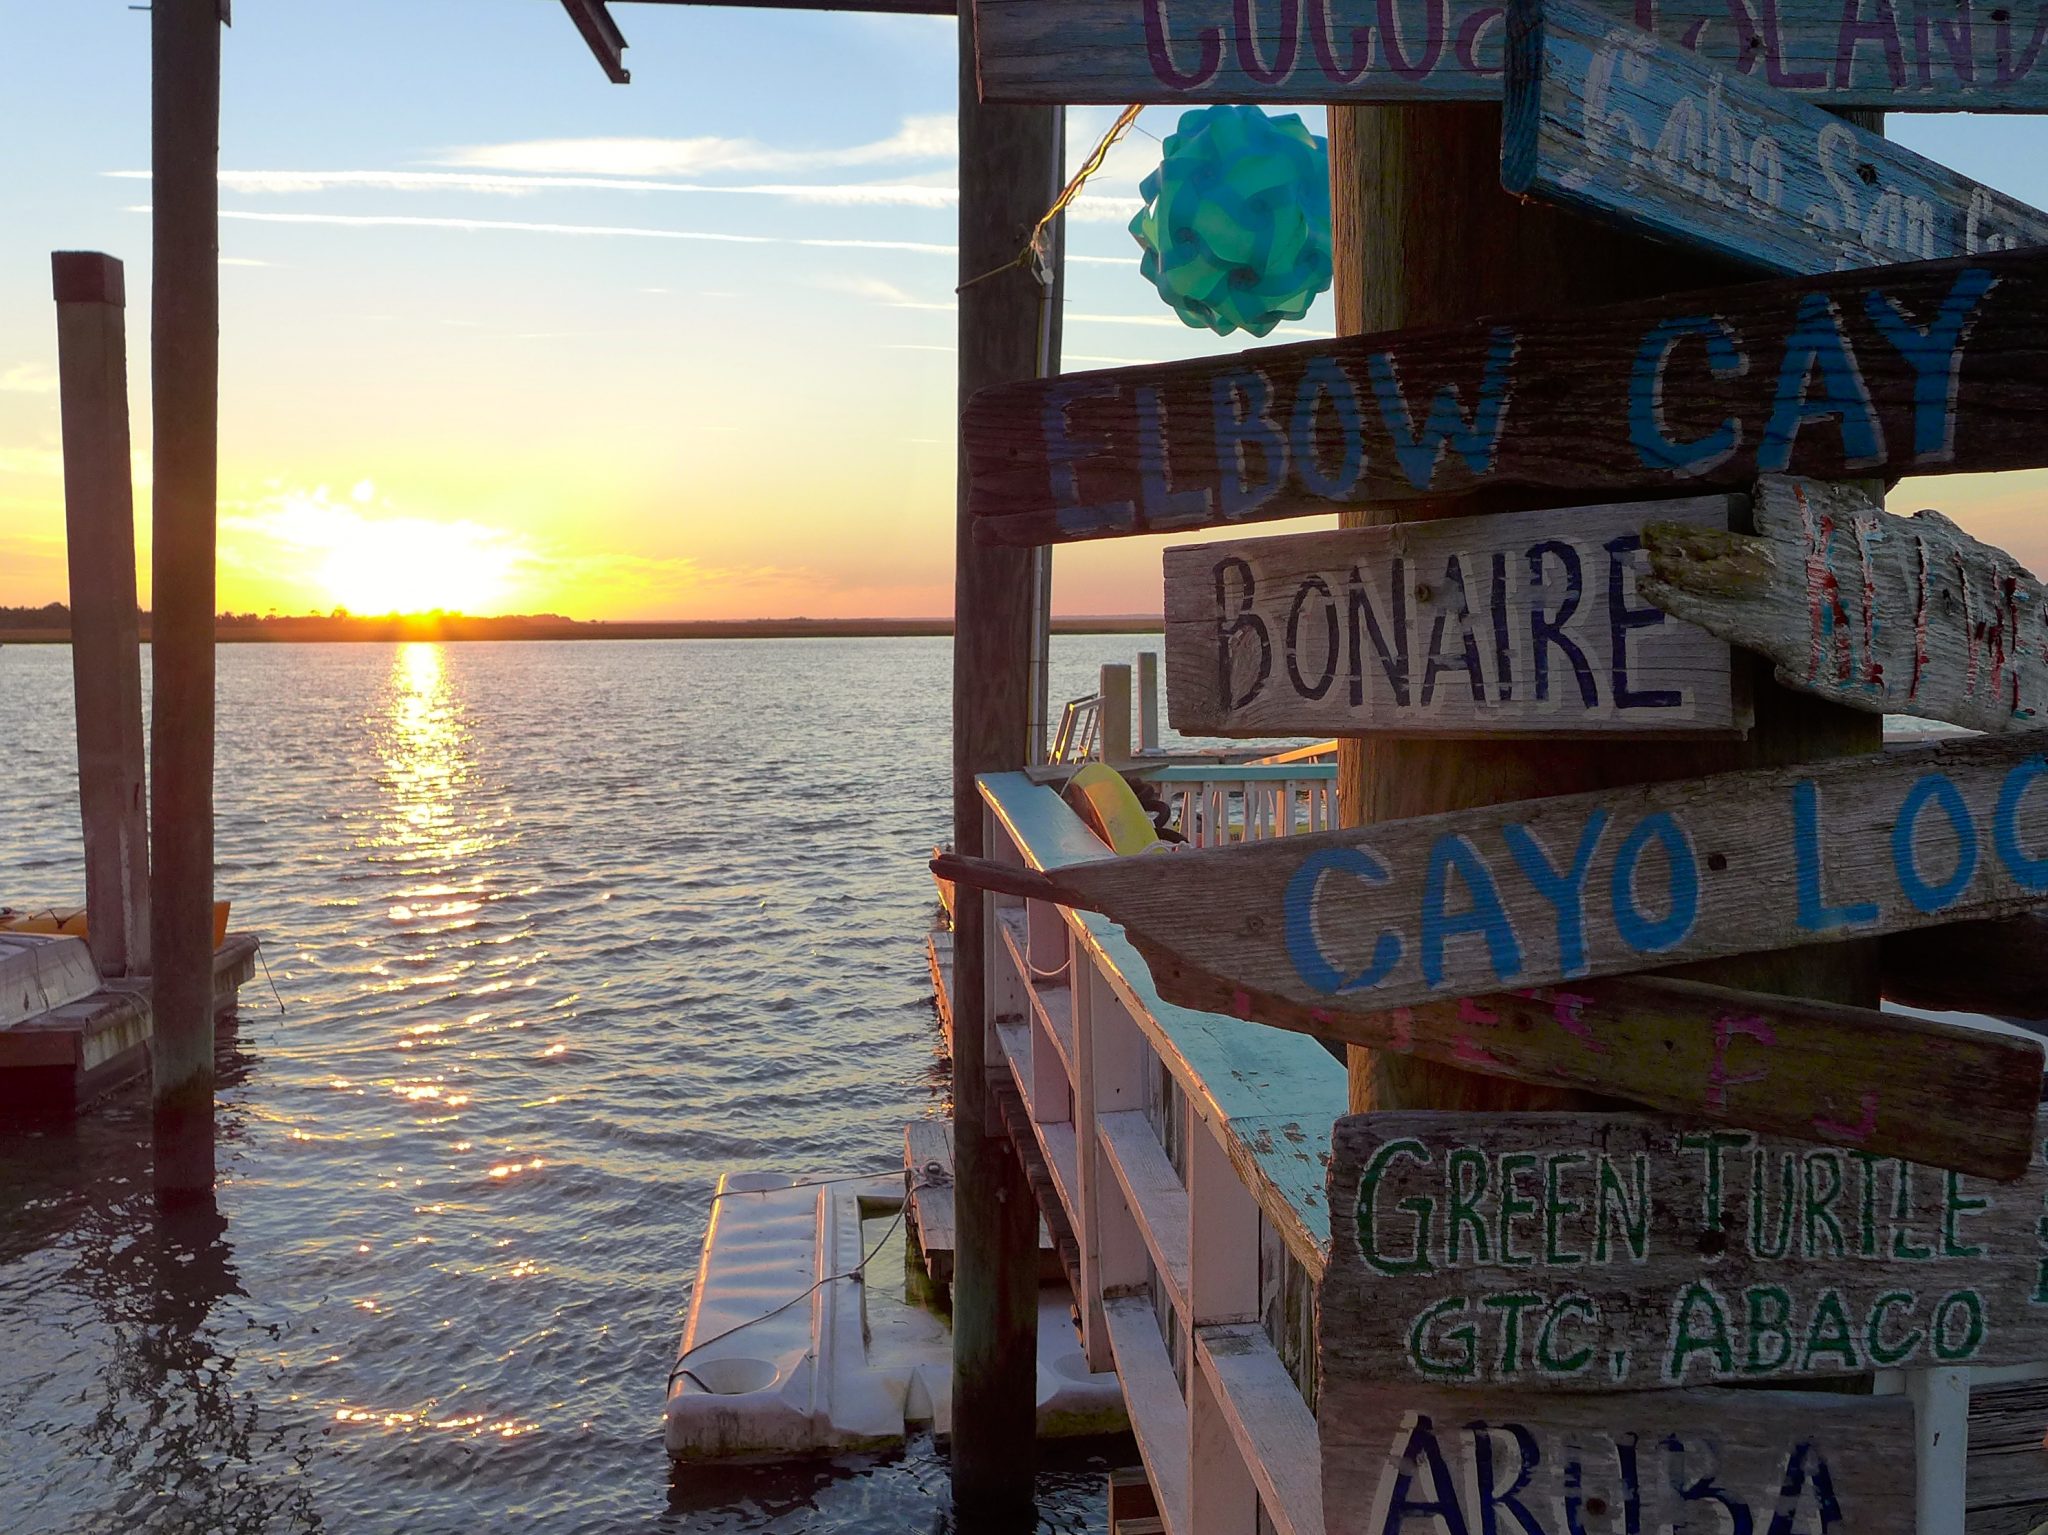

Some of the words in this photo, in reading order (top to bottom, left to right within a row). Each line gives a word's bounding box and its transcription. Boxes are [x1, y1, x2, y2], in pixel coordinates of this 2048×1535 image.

[1042, 325, 1519, 534] ELBOW
[1627, 268, 2001, 478] CAY
[1213, 535, 1690, 717] BONAIRE
[1284, 807, 1700, 994] CAYO
[1353, 1138, 1652, 1277] GREEN
[1674, 1130, 1993, 1261] TURTLE
[1661, 1278, 1991, 1383] ABACO
[1368, 1410, 1842, 1535] ARUBA
